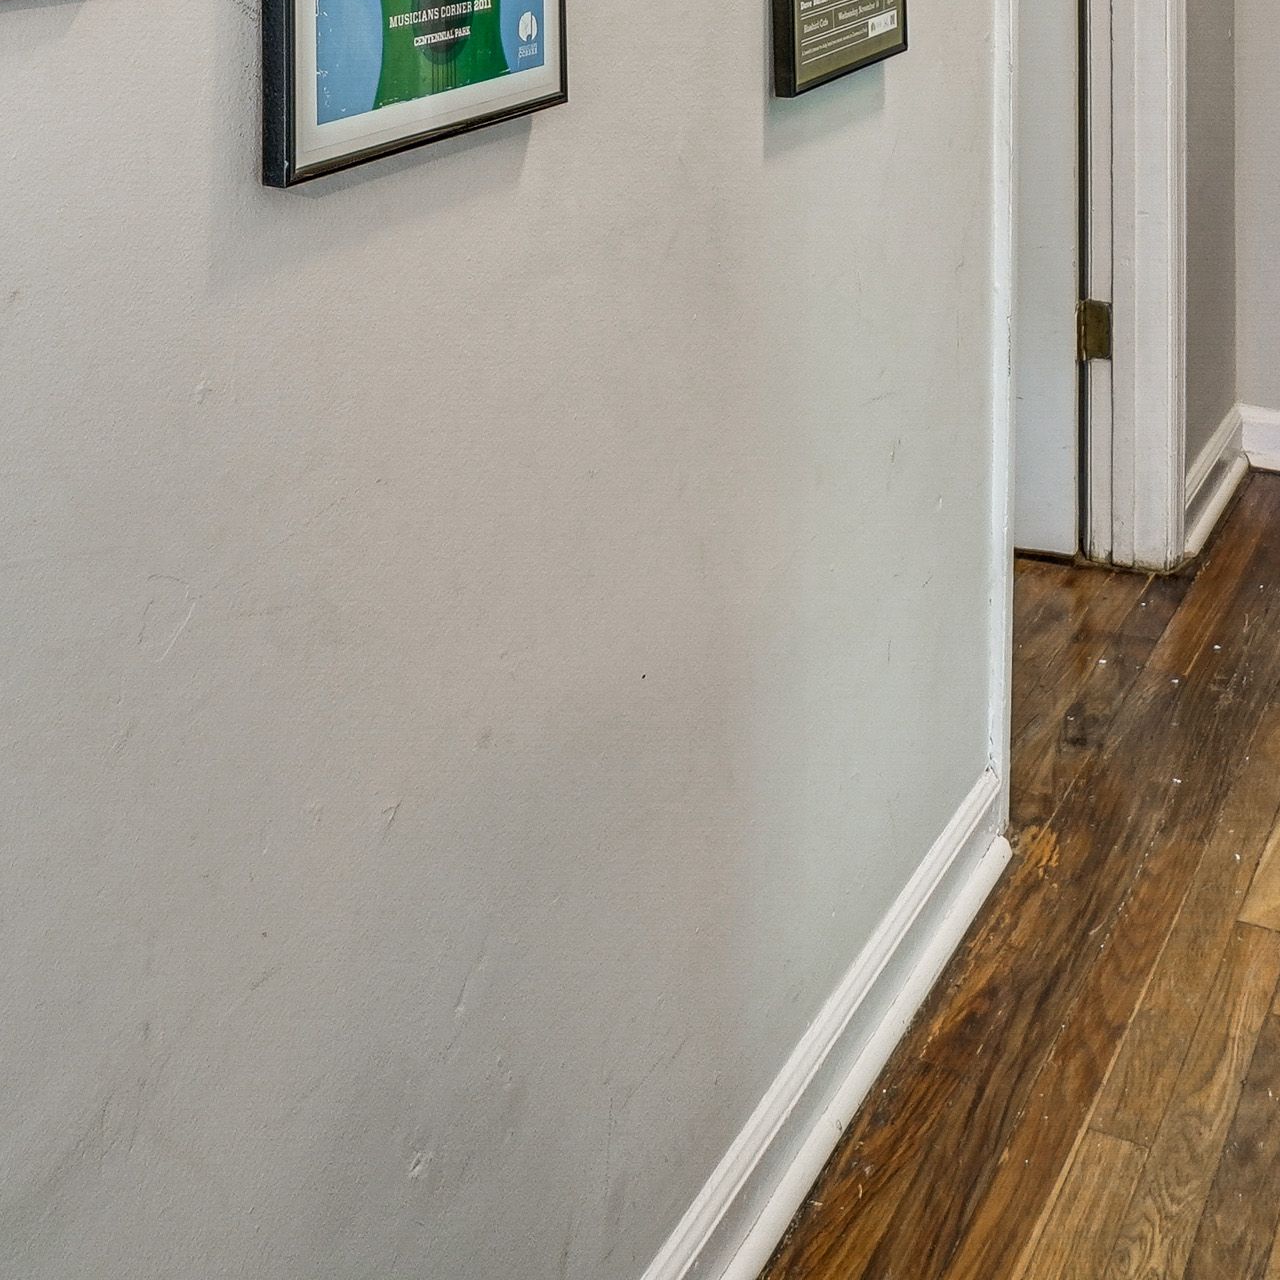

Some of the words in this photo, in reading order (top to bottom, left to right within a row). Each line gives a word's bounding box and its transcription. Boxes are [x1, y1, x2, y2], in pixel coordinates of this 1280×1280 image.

[389, 7, 439, 29] MUSICIANS
[440, 1, 473, 18] CORNER
[413, 29, 454, 47] CENTENNIAL
[455, 25, 471, 38] PARK
